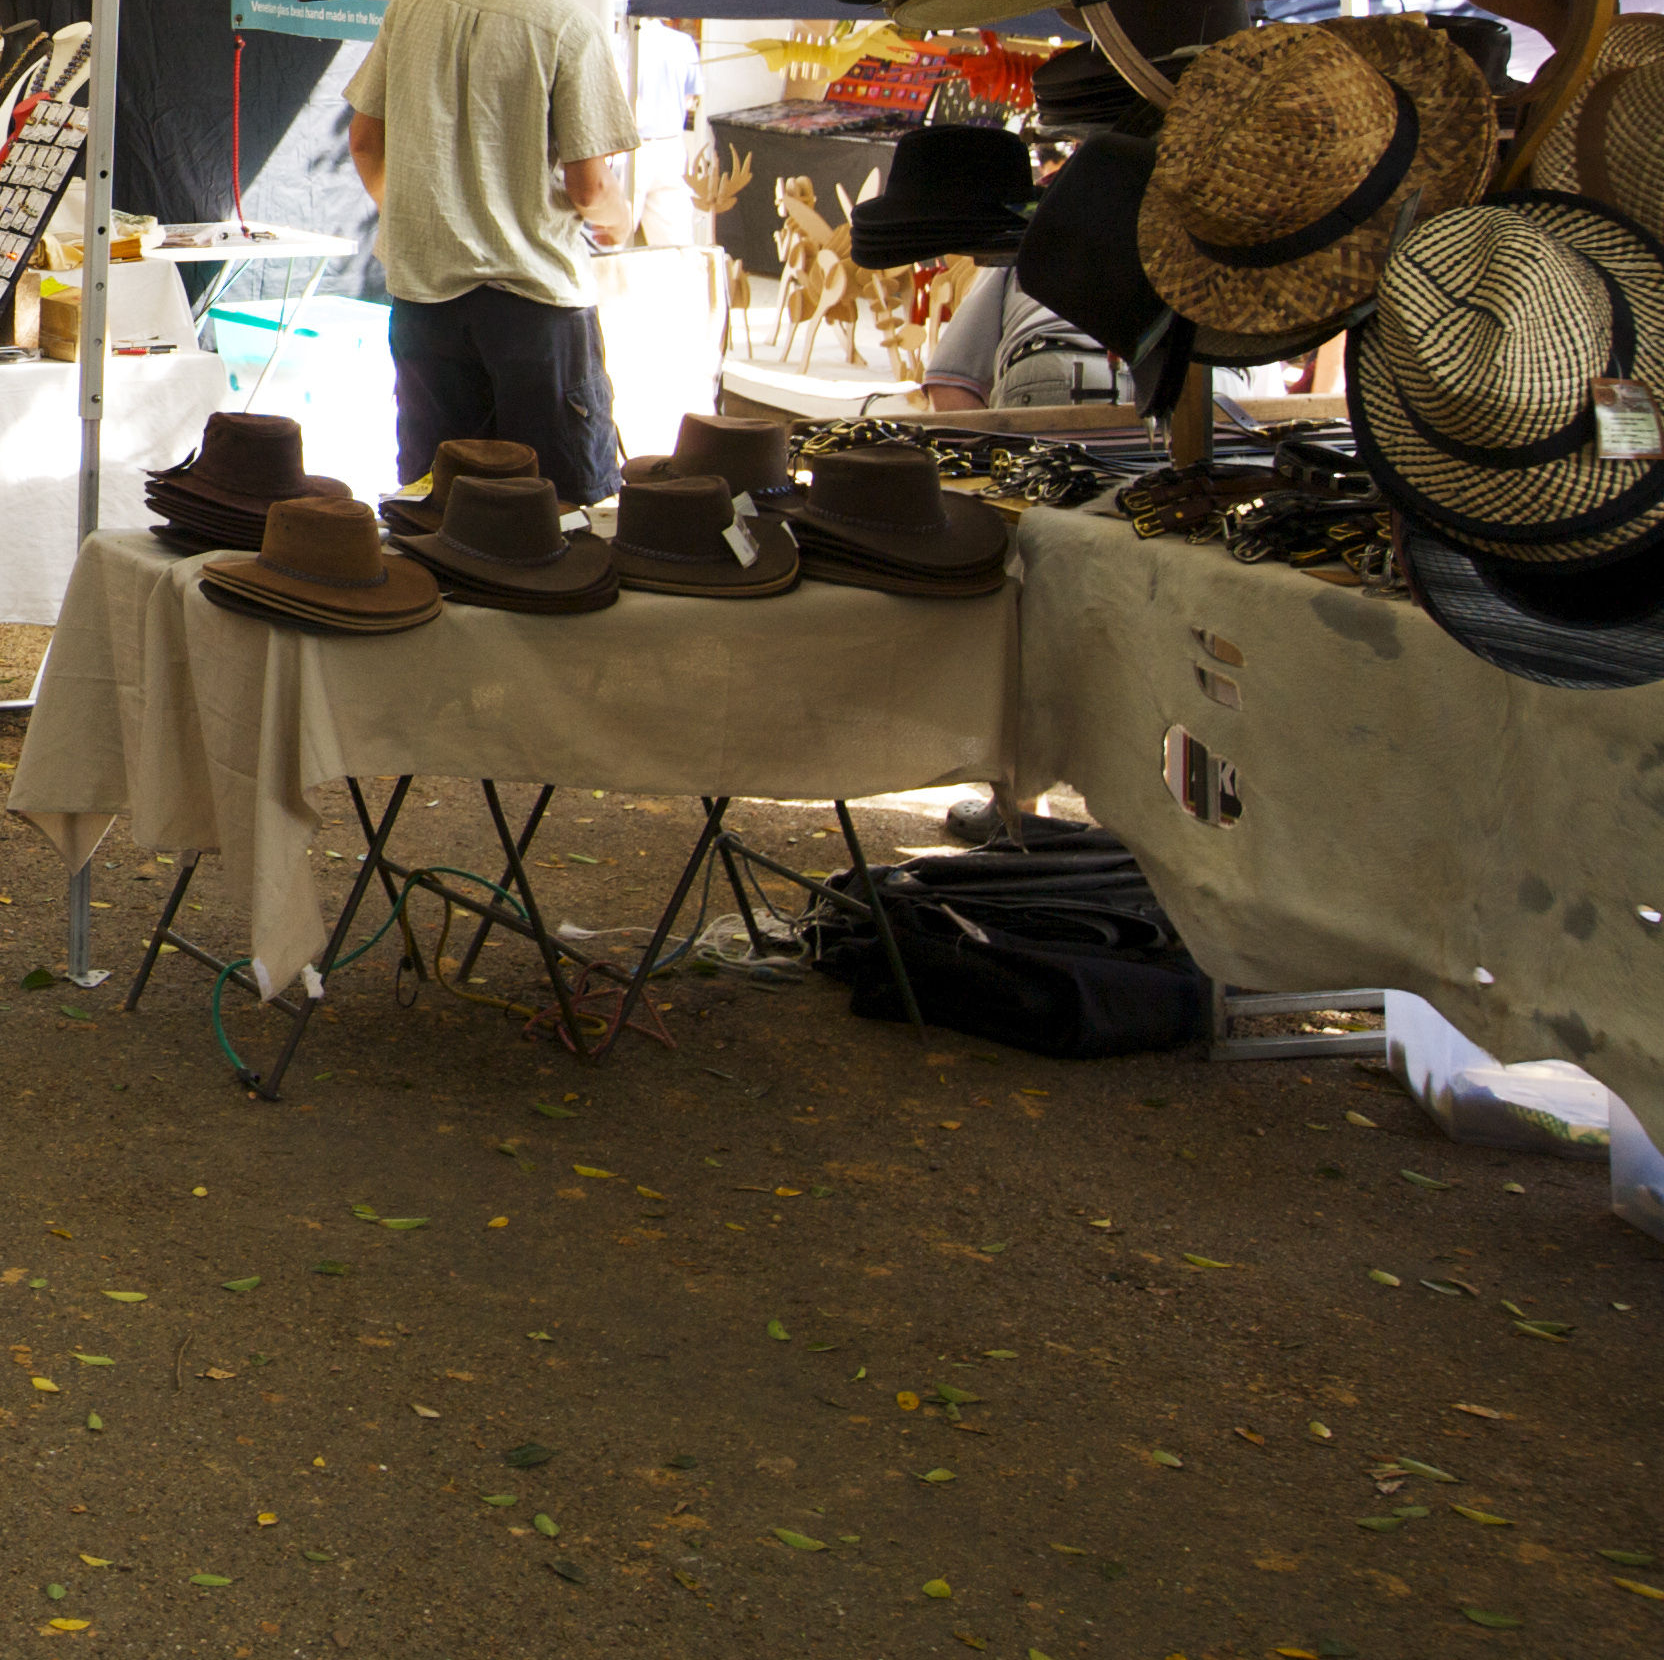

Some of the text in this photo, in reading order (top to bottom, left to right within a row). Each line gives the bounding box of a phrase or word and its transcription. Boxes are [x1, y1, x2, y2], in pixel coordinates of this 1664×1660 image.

[325, 8, 347, 23] made
[347, 11, 355, 23] in
[356, 11, 369, 25] the
